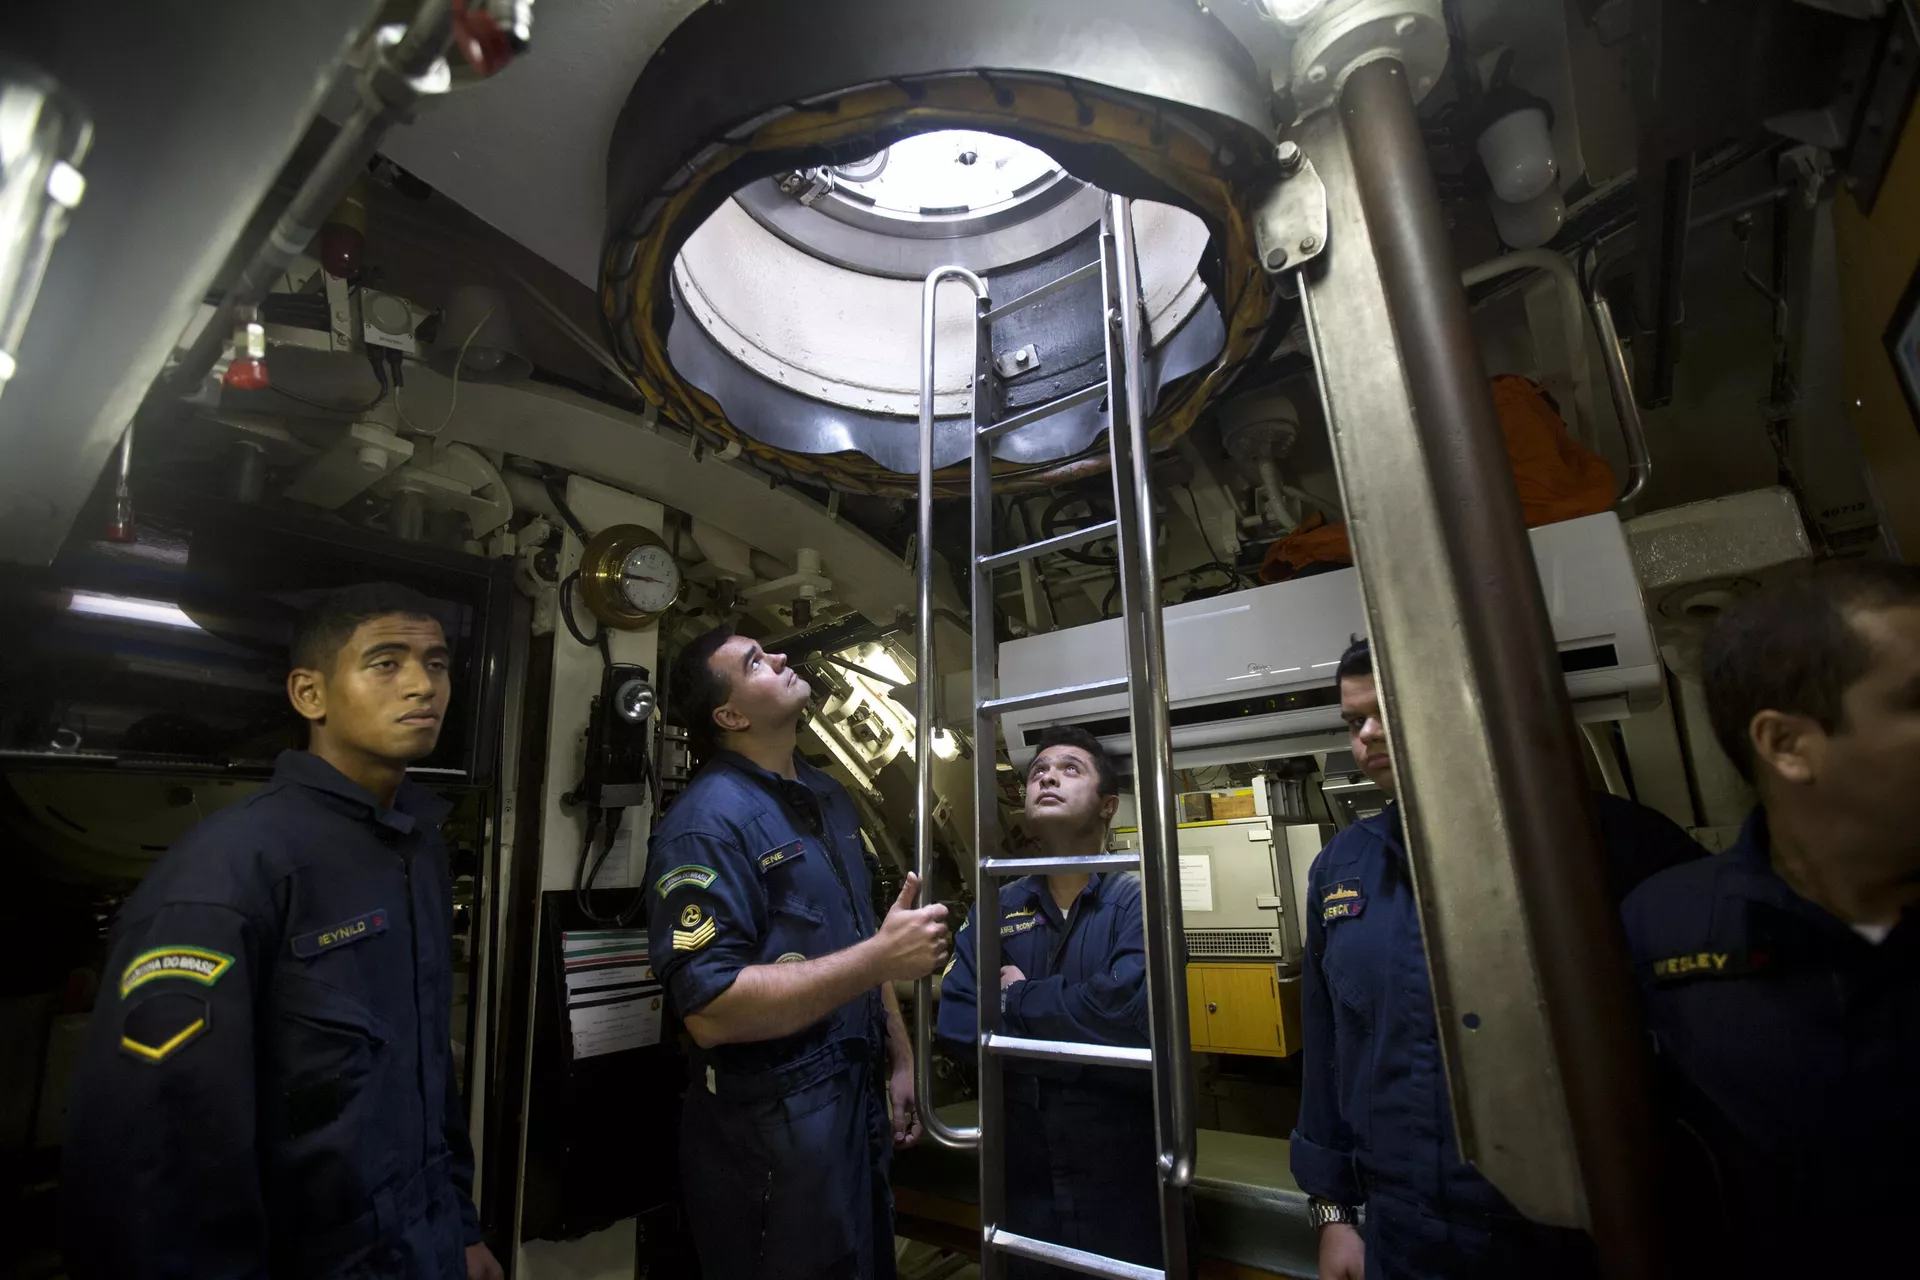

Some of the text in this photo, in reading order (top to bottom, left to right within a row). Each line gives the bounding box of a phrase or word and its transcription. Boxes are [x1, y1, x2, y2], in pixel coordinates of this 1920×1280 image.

[161, 955, 182, 969] DO
[179, 956, 217, 977] BRASIL
[1652, 952, 1729, 978] WESLEY
